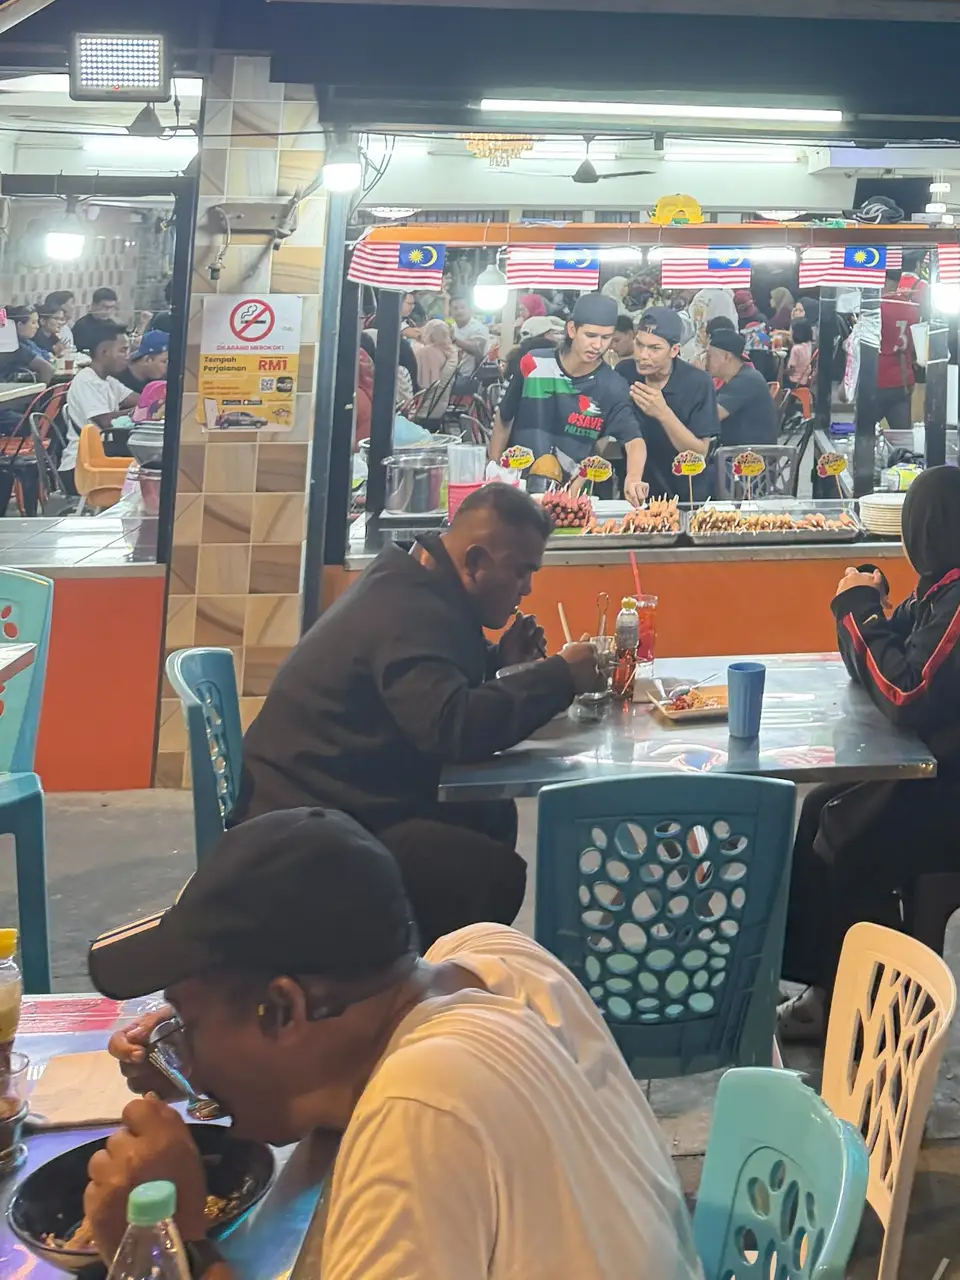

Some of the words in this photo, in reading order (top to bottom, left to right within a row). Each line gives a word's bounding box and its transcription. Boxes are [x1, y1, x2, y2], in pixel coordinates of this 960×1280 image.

[893, 319, 908, 352] 3
[204, 356, 237, 364] Tempah
[258, 359, 288, 371] RM1
[203, 365, 247, 373] Perjalanan
